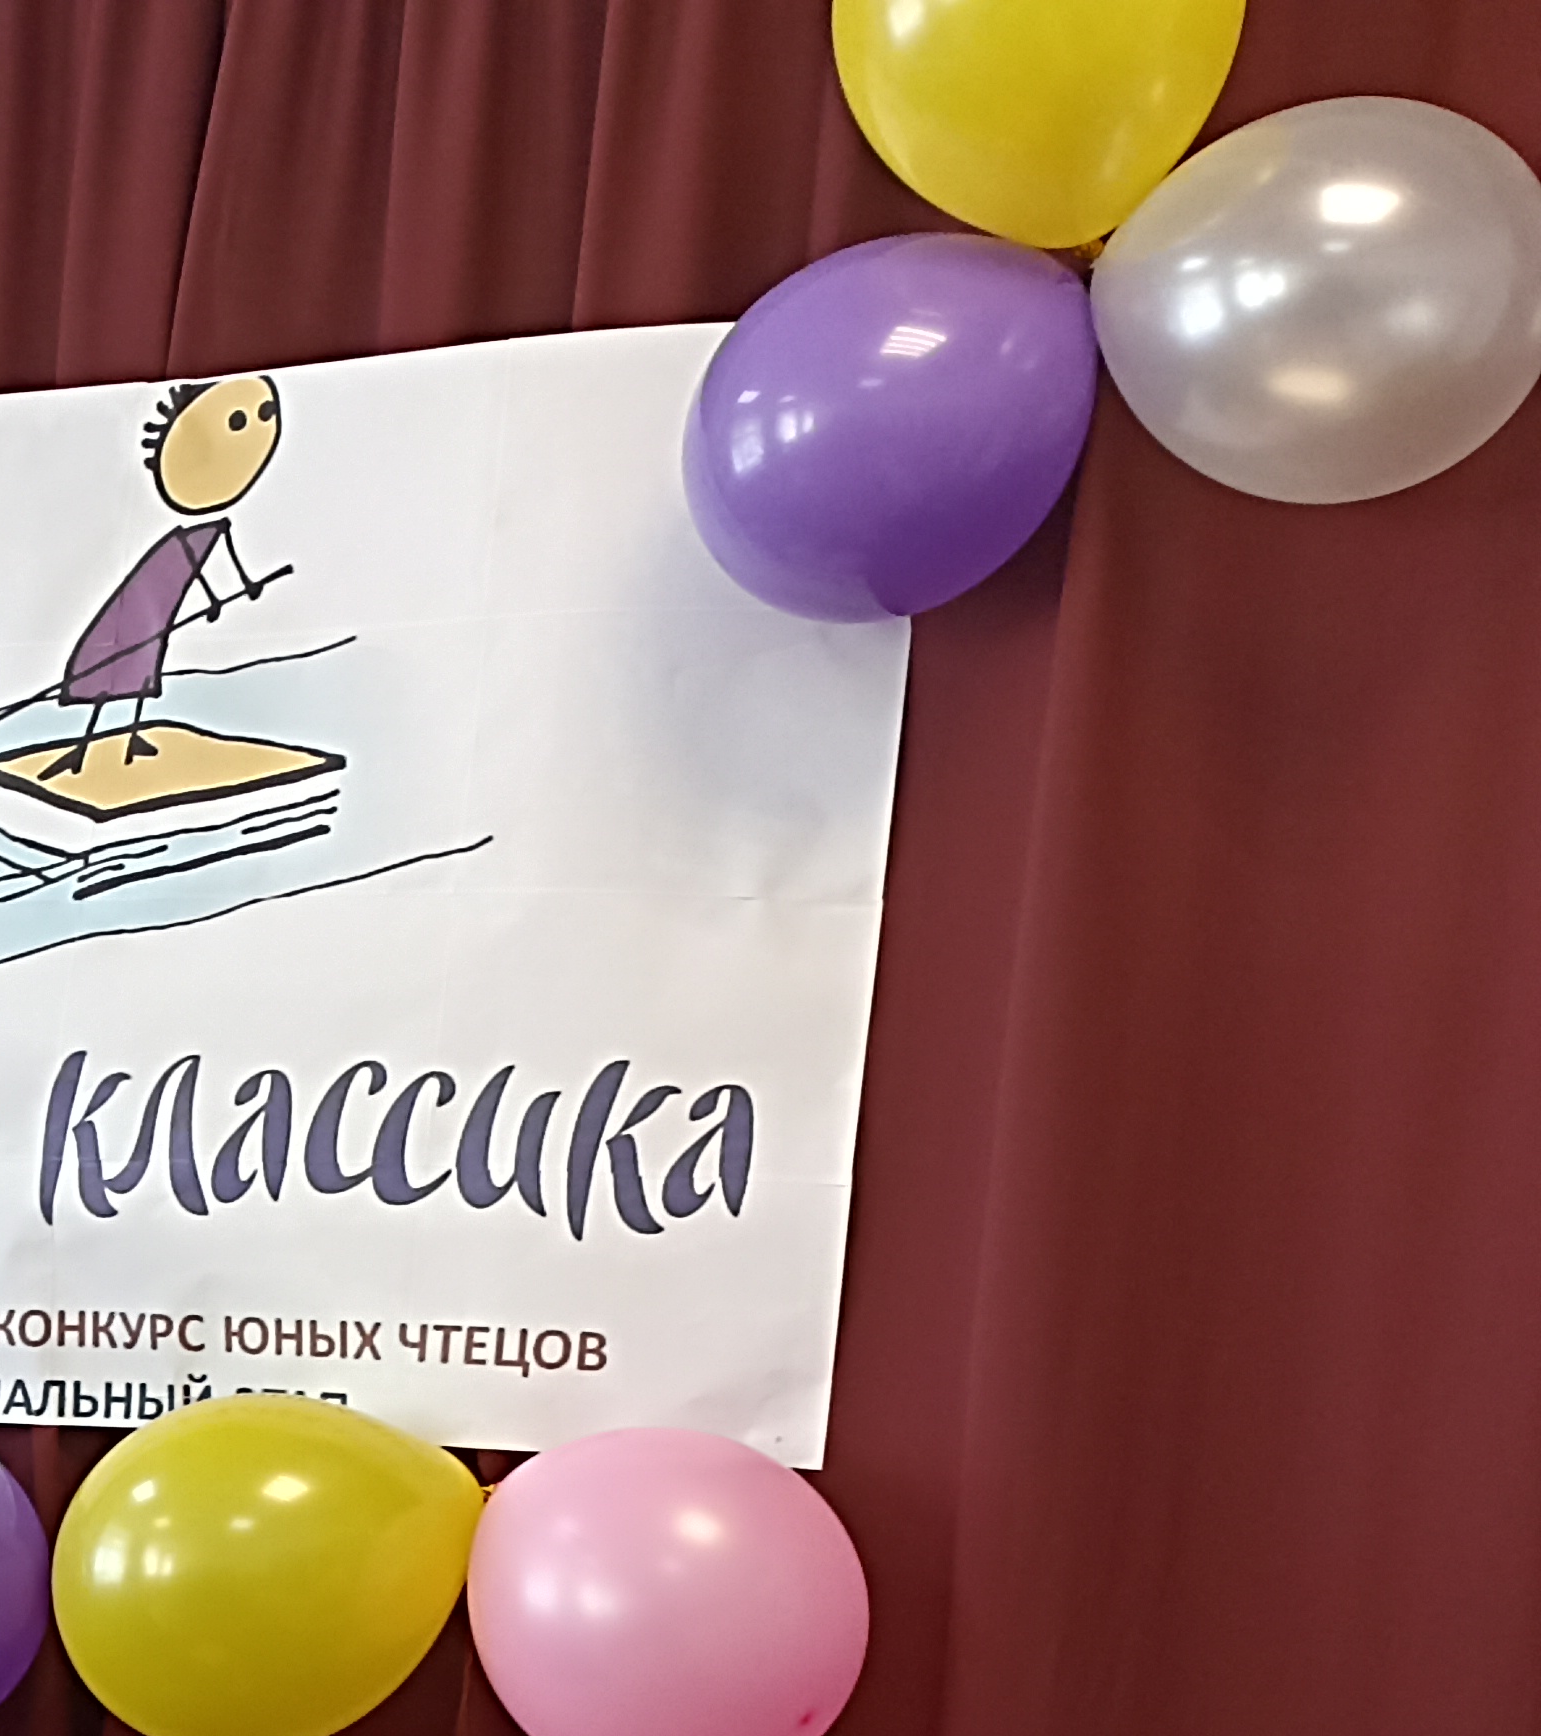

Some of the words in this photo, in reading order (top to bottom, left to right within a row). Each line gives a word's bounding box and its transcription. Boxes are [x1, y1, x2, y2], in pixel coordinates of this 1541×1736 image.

[39, 1050, 755, 1241] классика
[224, 1315, 382, 1362] ЮНЫХ
[398, 1322, 608, 1378] ЧТЕЦОВ
